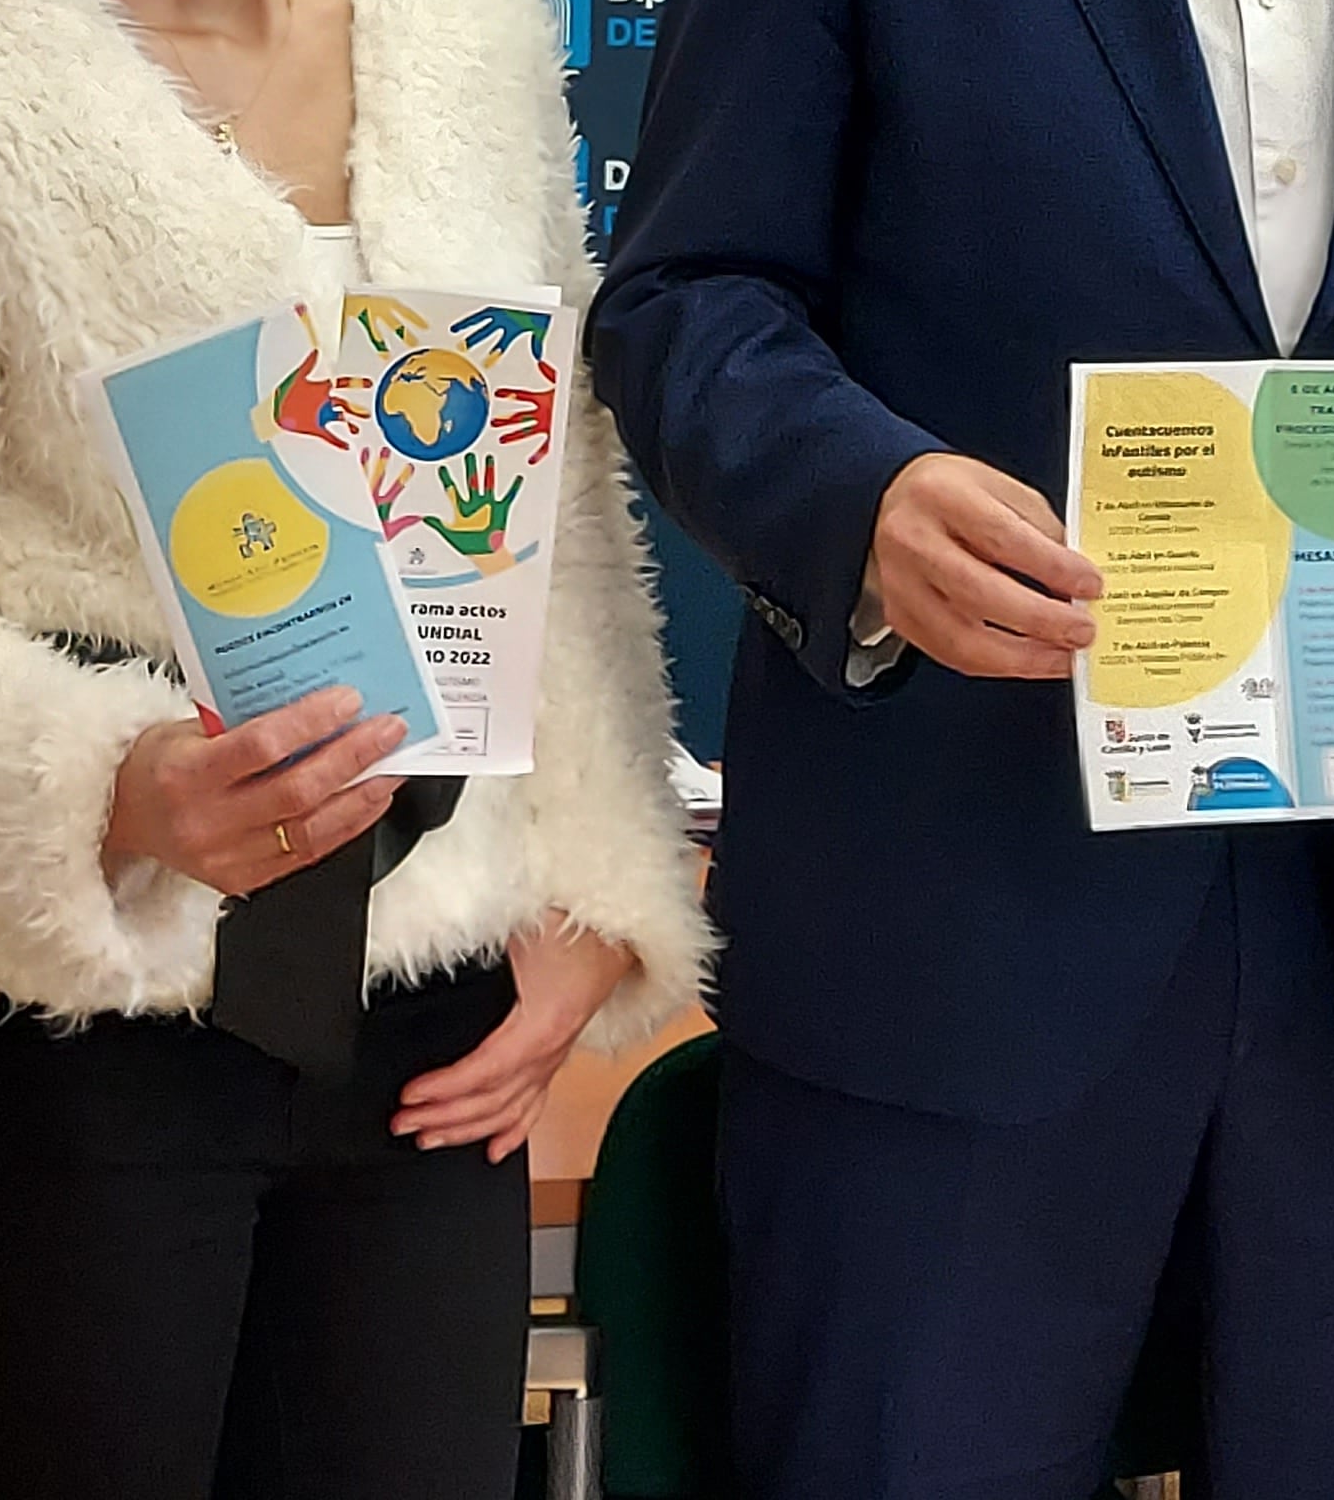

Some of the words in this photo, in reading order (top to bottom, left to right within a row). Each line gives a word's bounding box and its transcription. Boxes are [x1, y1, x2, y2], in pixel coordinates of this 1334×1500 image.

[606, 17, 657, 47] DE
[1105, 425, 1214, 438] Cuentacuentos
[1101, 444, 1171, 458] infantiles
[1173, 445, 1199, 459] por
[1202, 444, 1215, 457] el
[410, 603, 455, 616] rama
[459, 605, 507, 619] actos
[417, 625, 483, 641] UNDIAL
[449, 651, 492, 665] 2022
